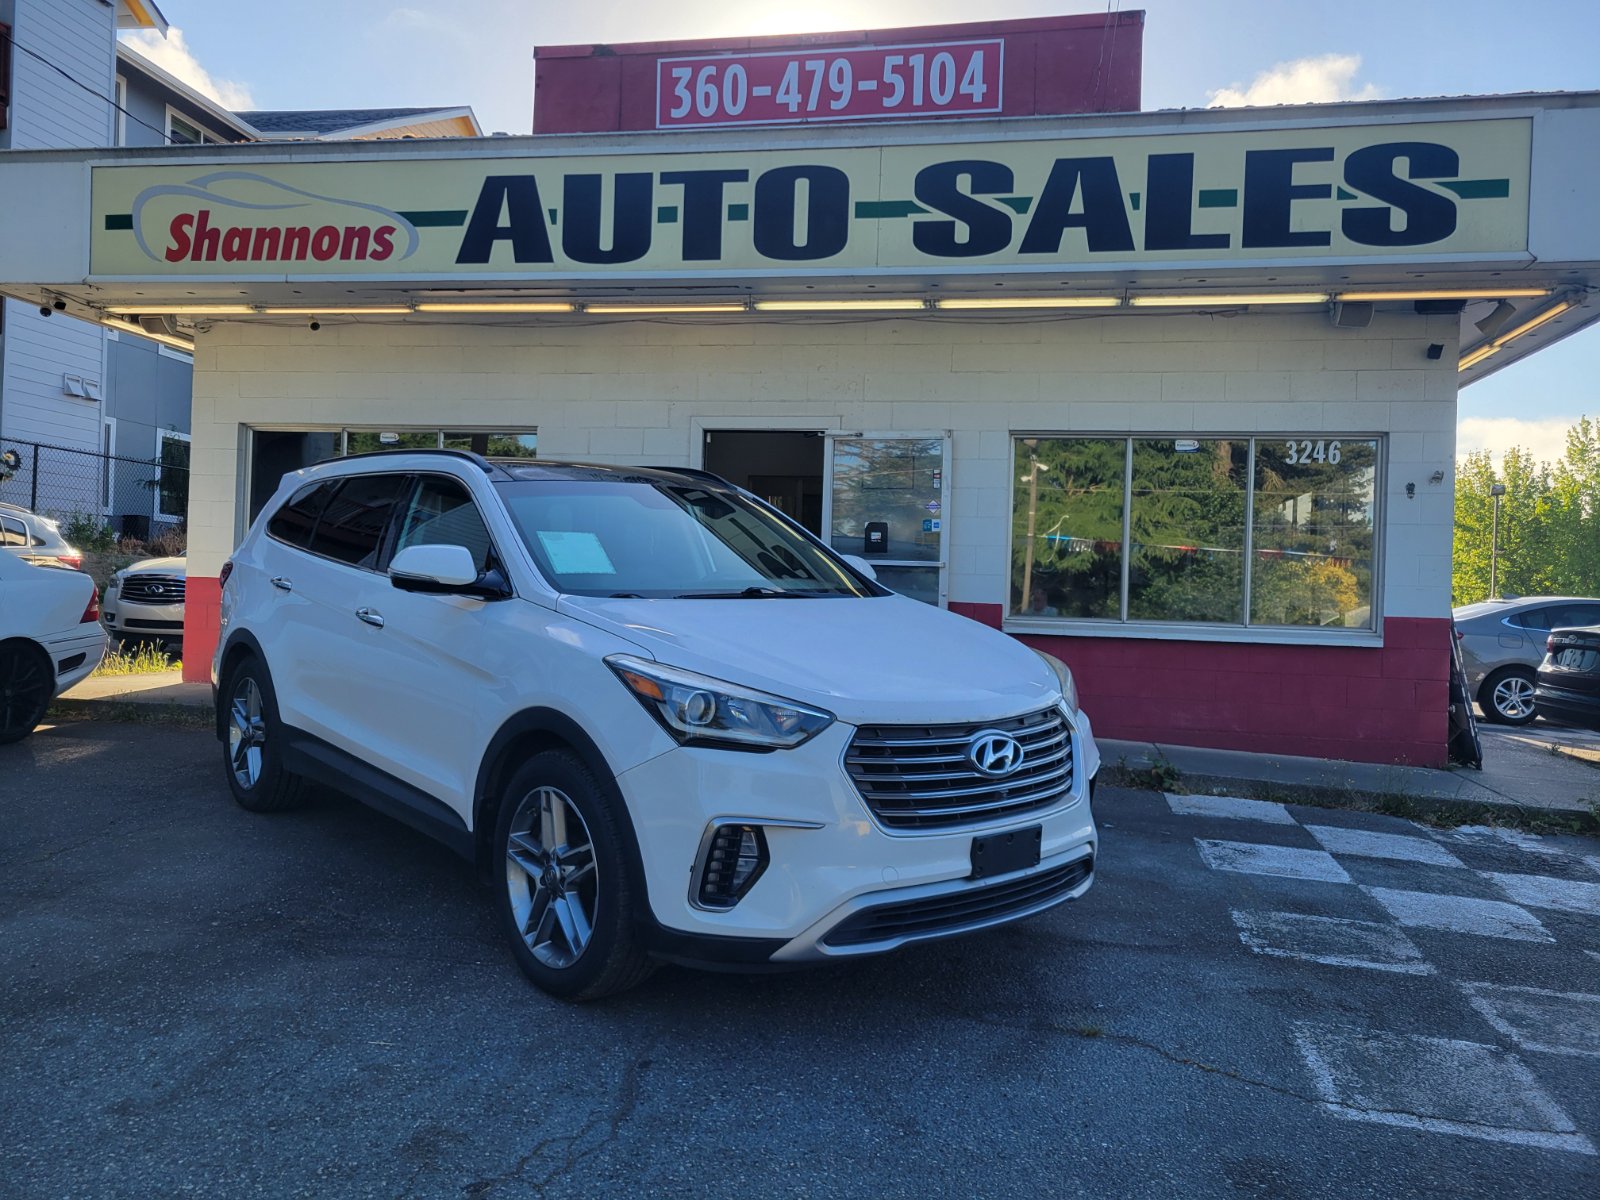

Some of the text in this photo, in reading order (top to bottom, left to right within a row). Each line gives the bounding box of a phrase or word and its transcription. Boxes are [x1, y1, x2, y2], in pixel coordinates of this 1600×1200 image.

[670, 50, 988, 119] 360-479-5104
[455, 141, 1459, 265] AUTO SALES
[165, 209, 396, 262] Shannons
[1285, 440, 1342, 465] 3246
